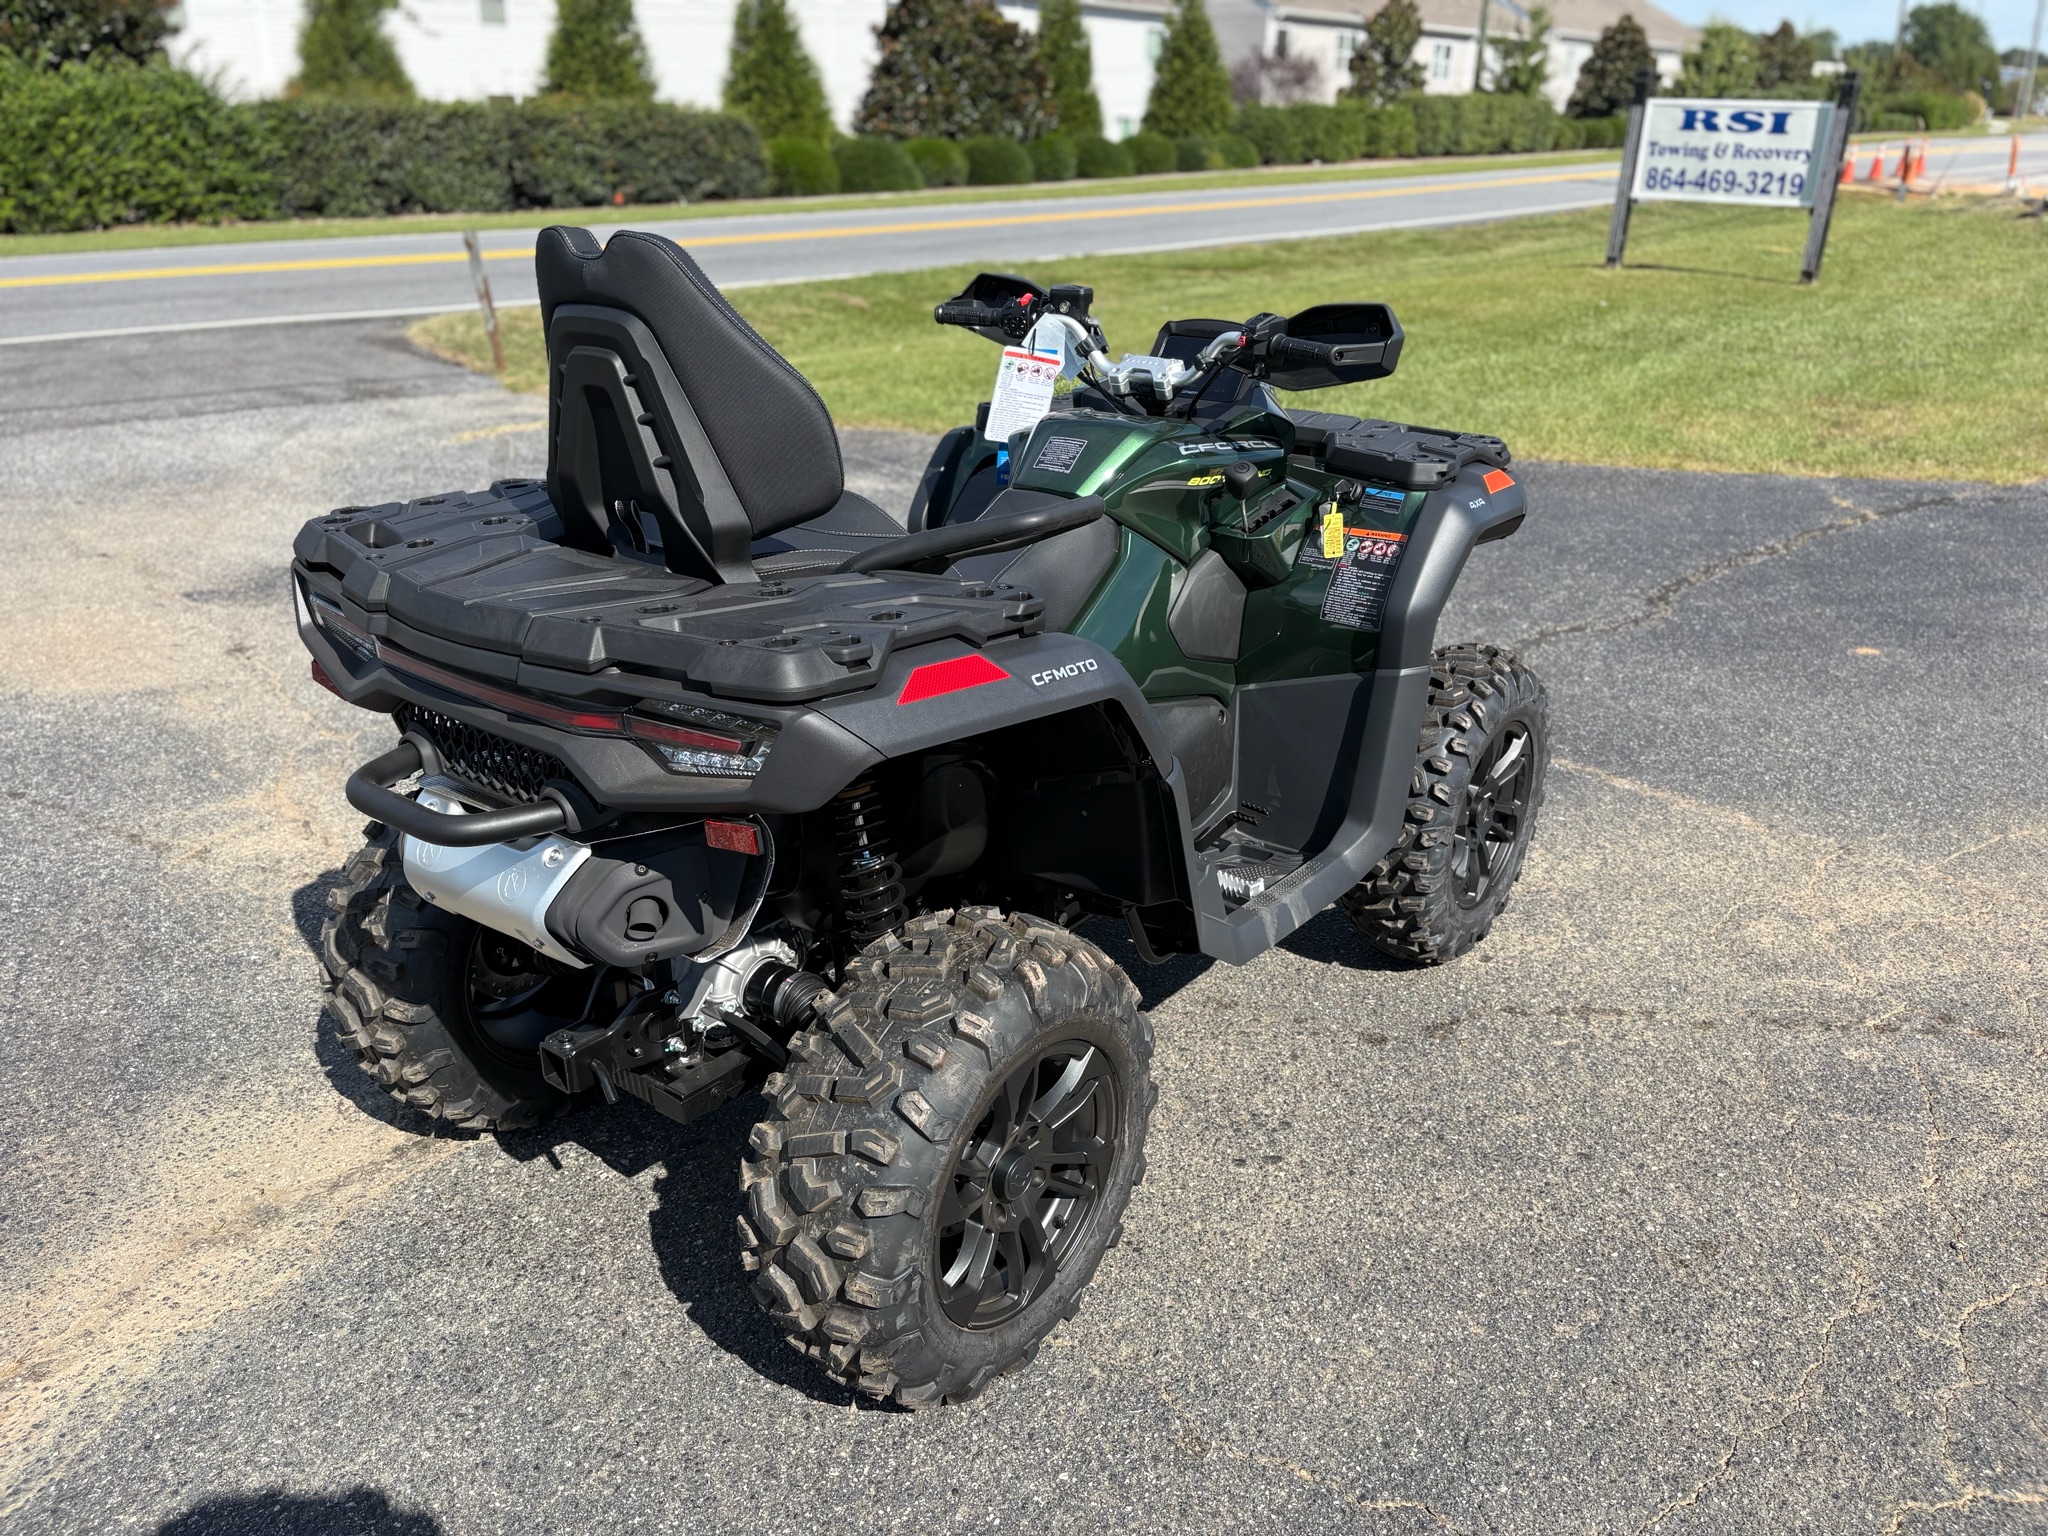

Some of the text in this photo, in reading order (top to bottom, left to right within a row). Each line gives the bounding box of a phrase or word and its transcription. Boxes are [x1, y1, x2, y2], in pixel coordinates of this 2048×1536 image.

[1680, 109, 1792, 134] RSI
[1649, 141, 1814, 164] Towing & Recovery
[1646, 167, 1804, 196] 864-469-3219
[1179, 440, 1280, 455] CFORCE
[1031, 659, 1098, 686] CFMOTO
